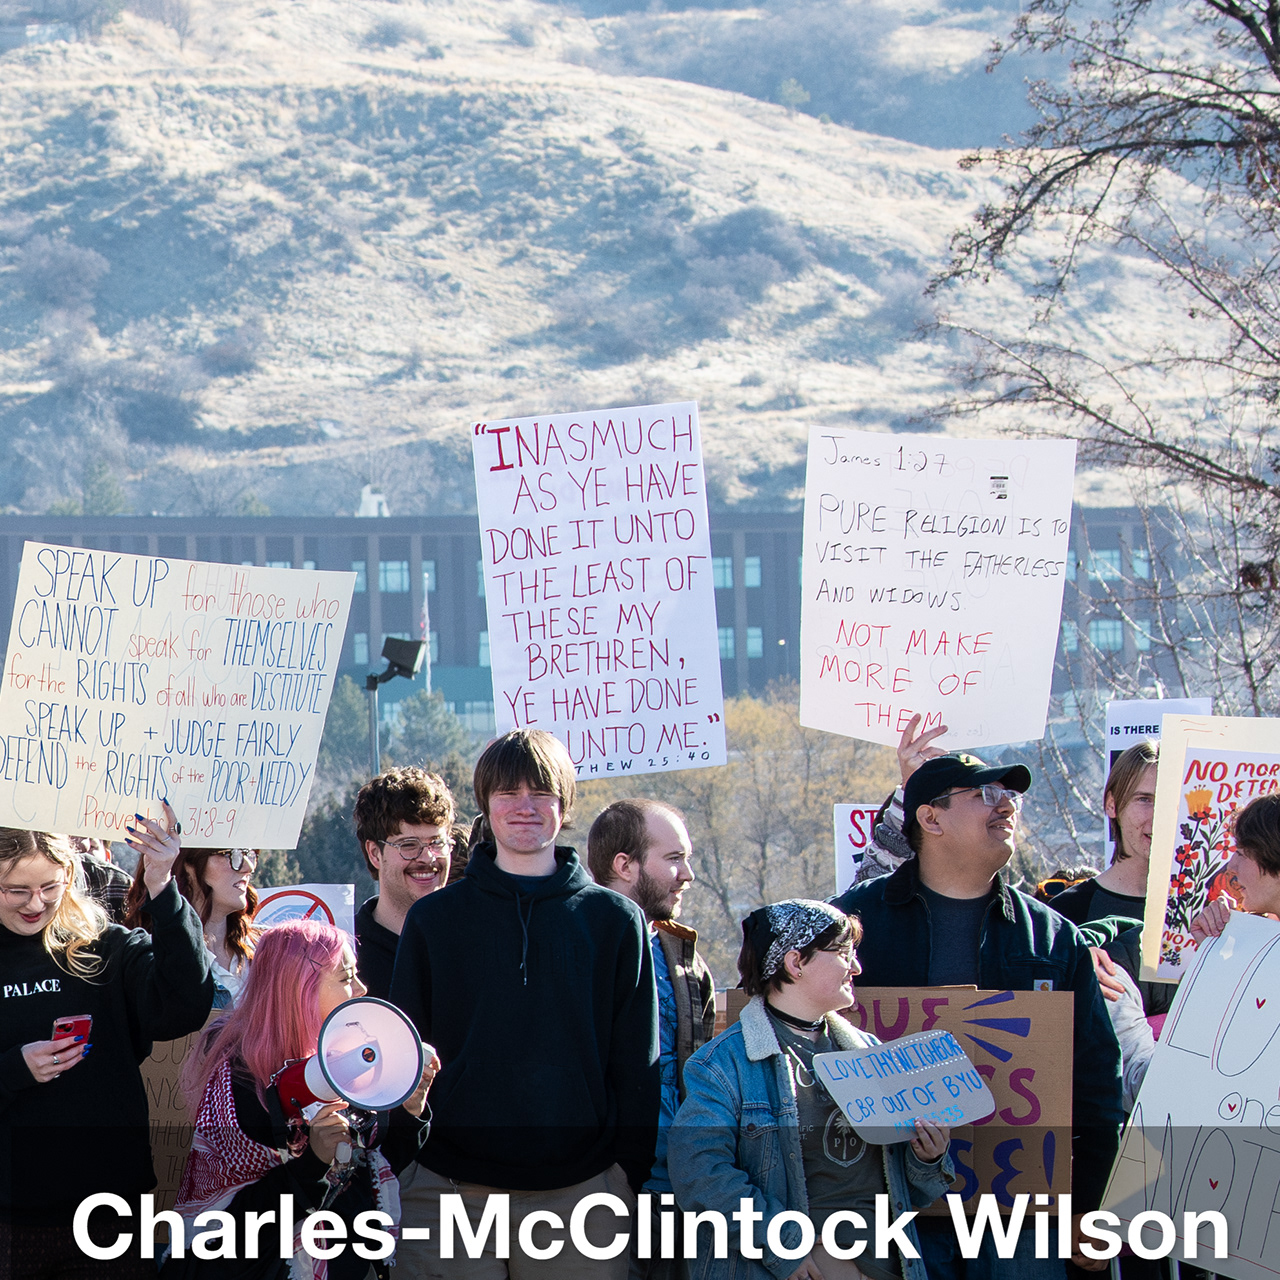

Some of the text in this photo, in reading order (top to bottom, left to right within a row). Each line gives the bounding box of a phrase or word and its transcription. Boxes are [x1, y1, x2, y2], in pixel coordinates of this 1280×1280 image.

[474, 414, 693, 472] "INASMUCH
[821, 435, 949, 474] James 1:27
[512, 461, 699, 514] AS YE HAVE
[486, 509, 695, 564] DONE IT UNTO
[819, 493, 1068, 539] PURE RELIGION IS TO
[492, 556, 707, 606] THE LEAST OF
[815, 541, 1065, 579] VISIT THE FATHERLESS
[34, 548, 340, 619] SPEAK UP for those who
[815, 579, 966, 611] AND WIDOWS.
[18, 599, 333, 671] CANNOT speak for THEMSELVES
[502, 601, 661, 642] THESE MY
[836, 619, 993, 656] NOT MAKE
[524, 638, 686, 682] BRETHREN,
[820, 655, 982, 695] MORE OF
[7, 652, 328, 714] for the RIGHTS of all who are DESTITUTE
[503, 678, 699, 728] YE HAVE DONE
[24, 699, 302, 758] SPEAK UP + JUDGE FAIRLY
[568, 713, 721, 765] UNTO ME."
[855, 703, 942, 734] THEM
[1110, 725, 1160, 735] IS THERE
[74, 756, 97, 772] the
[104, 750, 172, 801] RIGHTS
[171, 768, 186, 784] of
[188, 767, 205, 784] the
[207, 759, 249, 804] POOR
[648, 751, 710, 767] 25:40
[1184, 759, 1228, 784] NO
[183, 808, 238, 838] 31:8-9
[1163, 930, 1184, 945] NO
[3, 979, 61, 998] PALACE
[822, 1032, 965, 1081] LOVE THY NEIGHBOR
[846, 1070, 982, 1123] CBP OUT OF BYU
